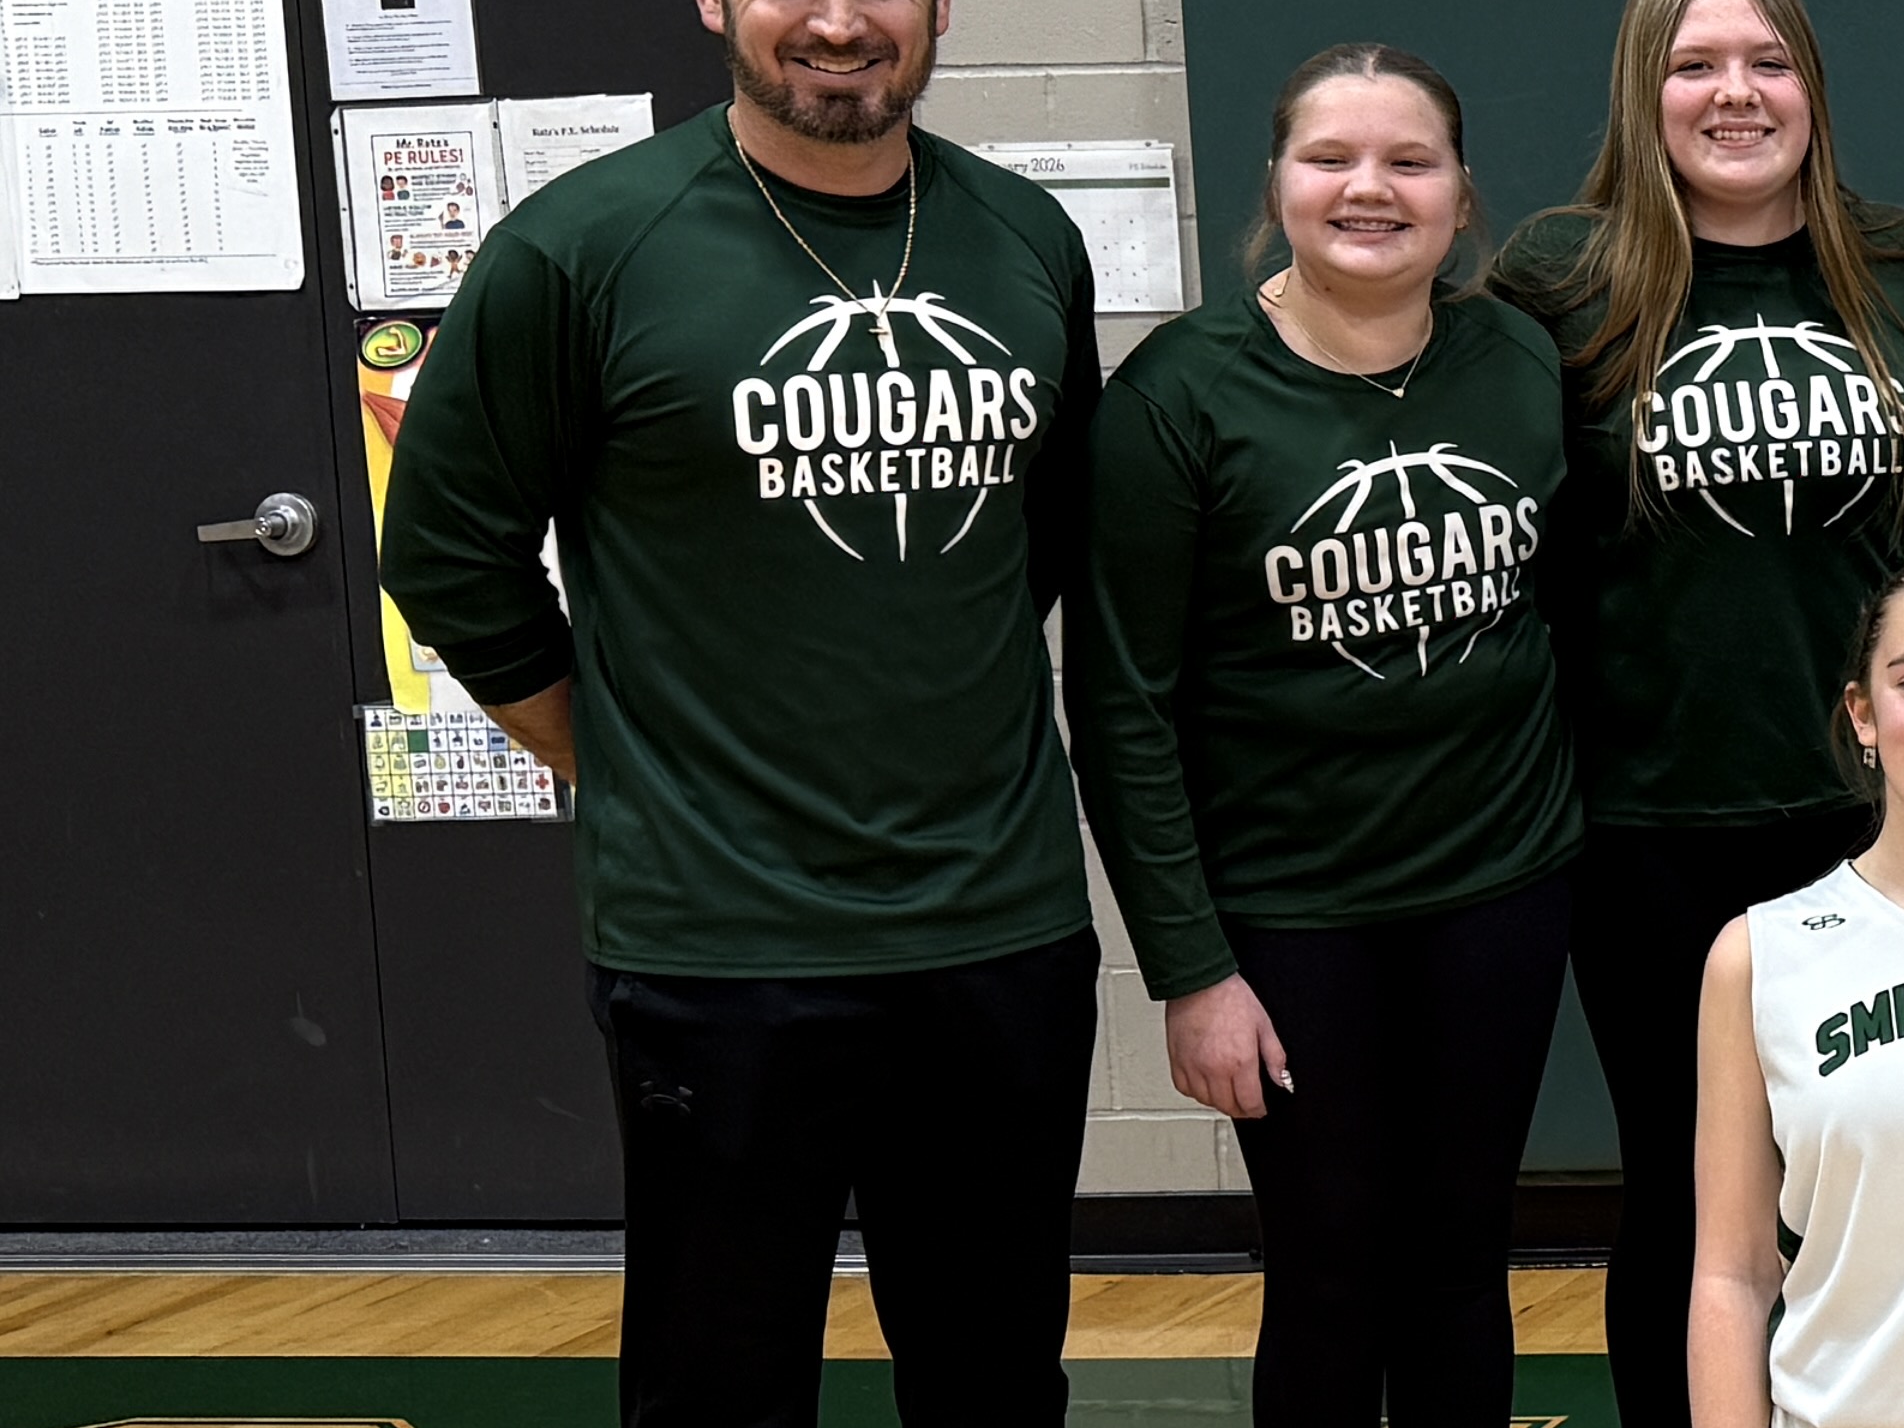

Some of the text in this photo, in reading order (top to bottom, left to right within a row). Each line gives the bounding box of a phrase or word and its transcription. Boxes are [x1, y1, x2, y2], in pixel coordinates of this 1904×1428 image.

[384, 148, 464, 166] PE RULES!
[1030, 157, 1065, 172] 2026
[731, 366, 1038, 455] COUGARS
[758, 443, 1015, 500] BASKETBALL
[1654, 437, 1903, 492] BASKETBALL
[1264, 495, 1539, 605] COUGARS
[1290, 566, 1521, 642] BASKETBALL
